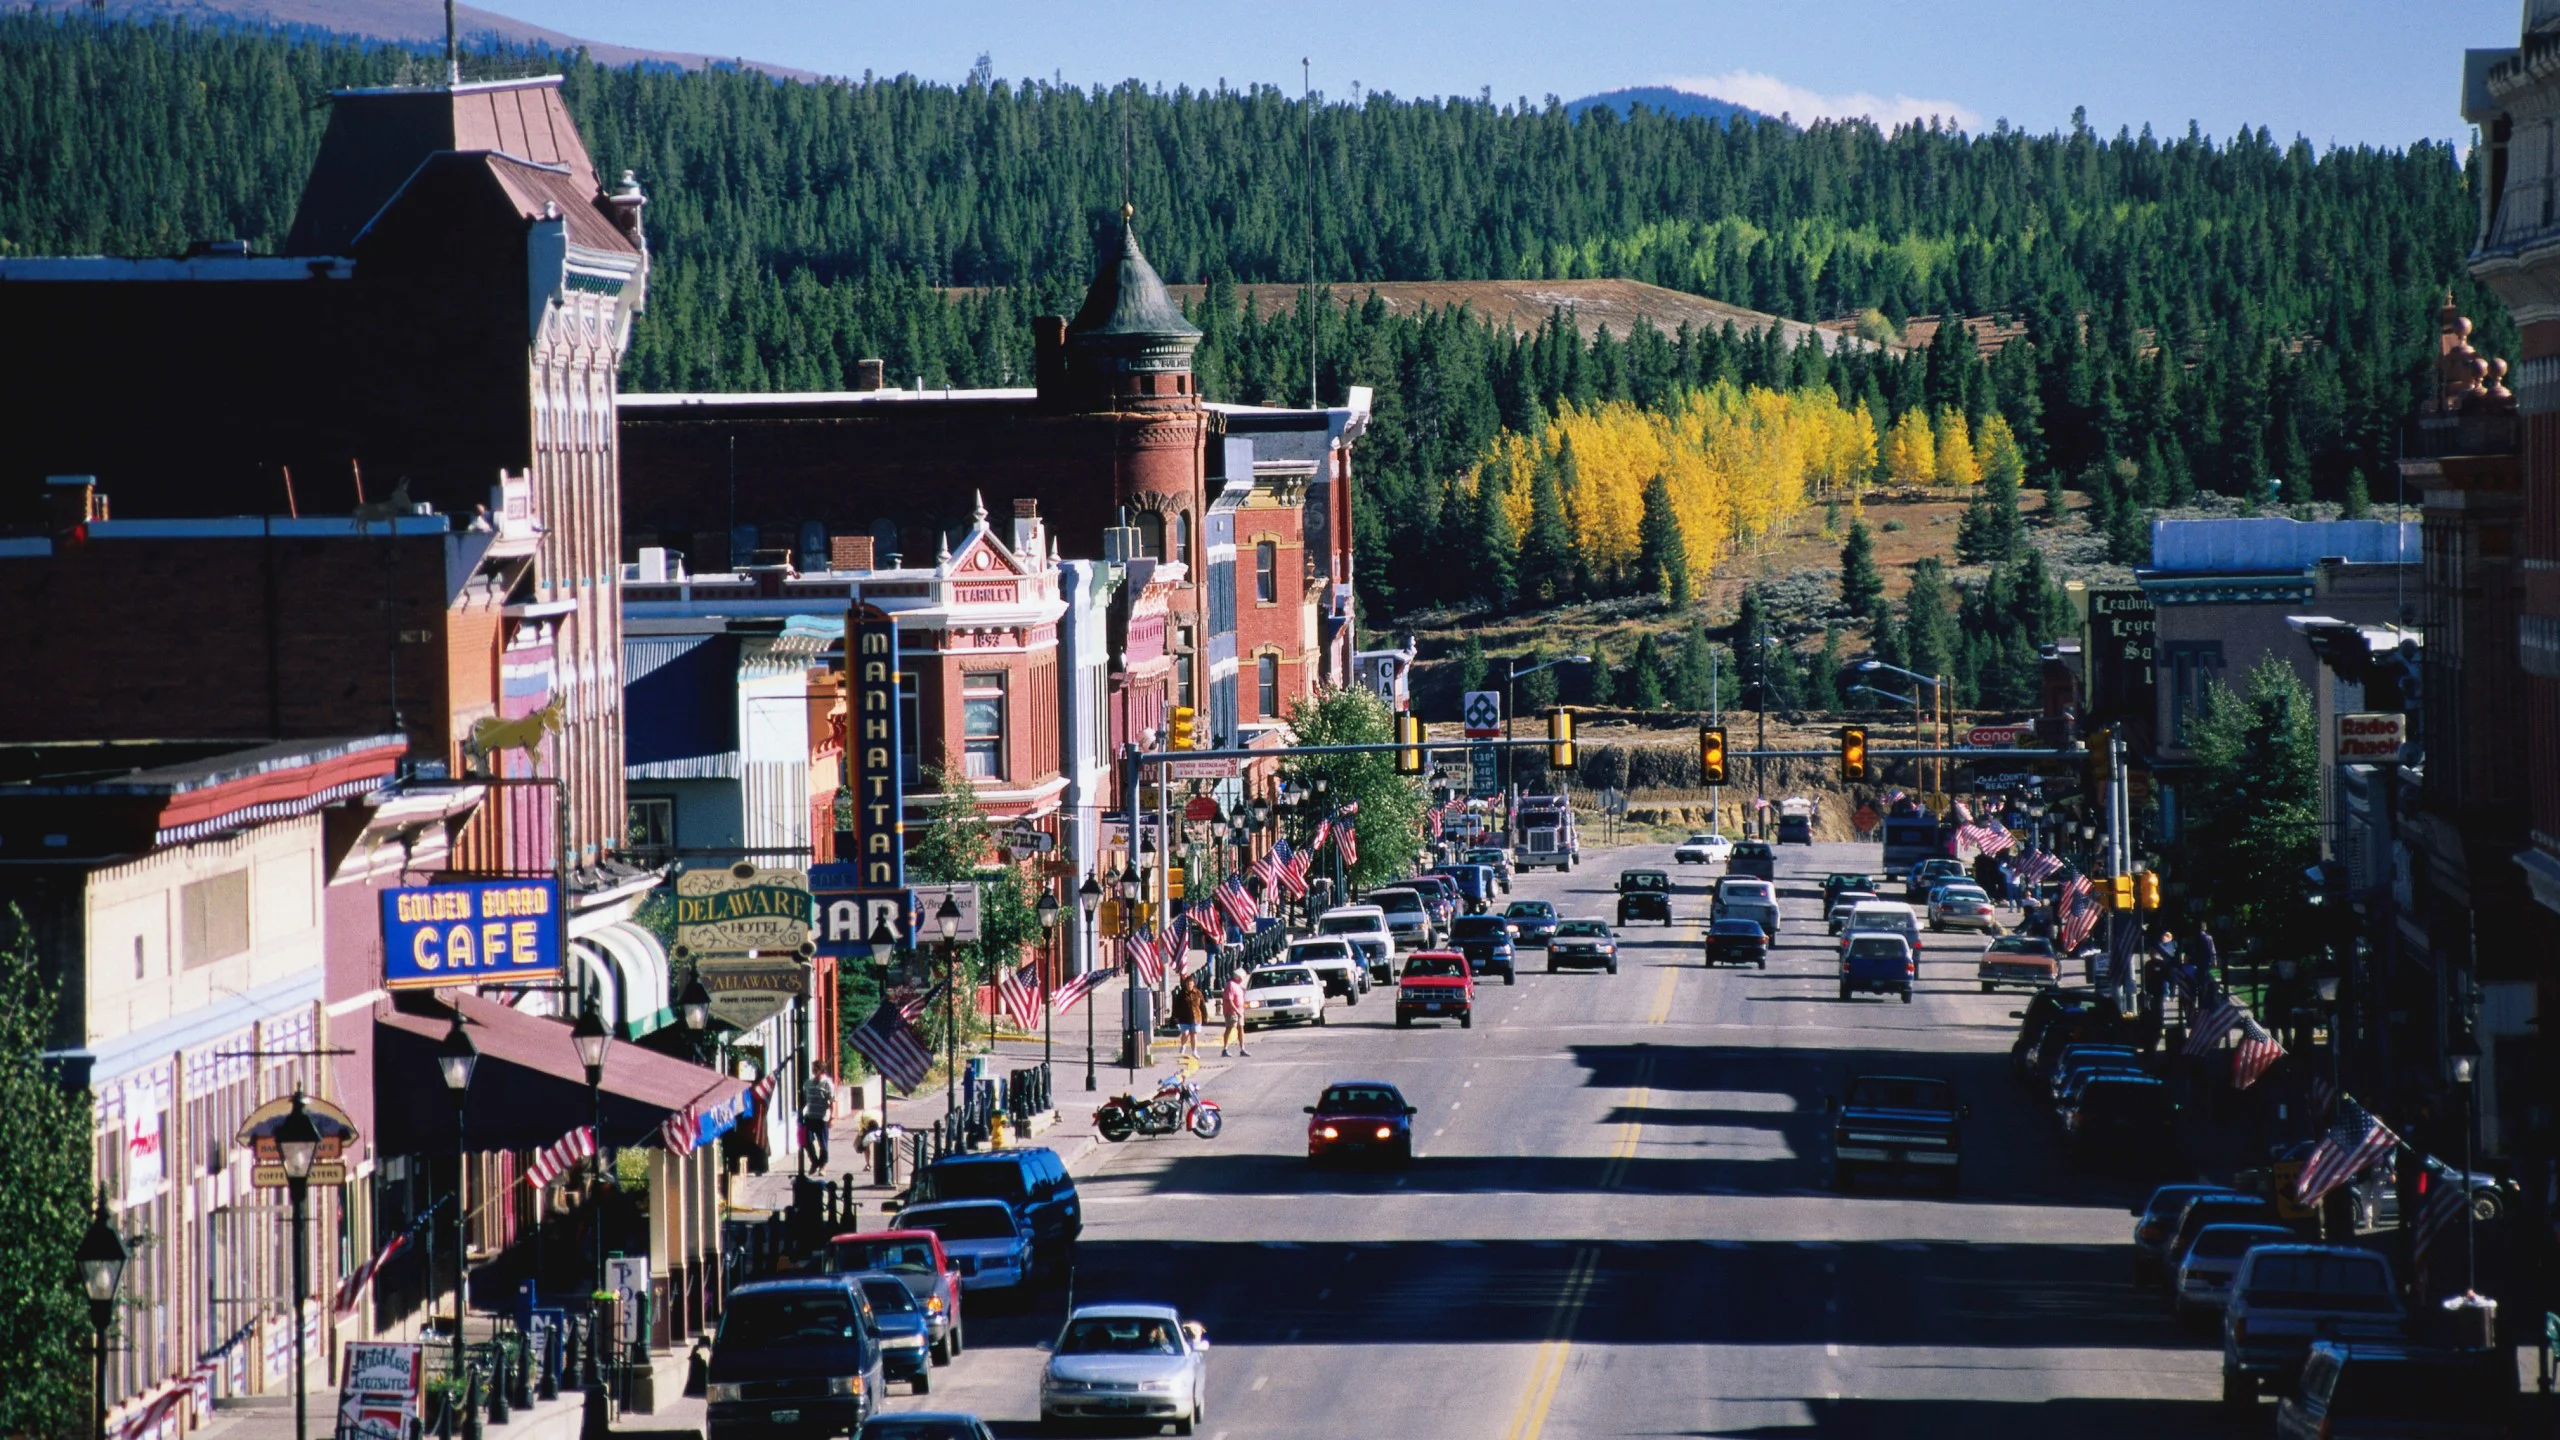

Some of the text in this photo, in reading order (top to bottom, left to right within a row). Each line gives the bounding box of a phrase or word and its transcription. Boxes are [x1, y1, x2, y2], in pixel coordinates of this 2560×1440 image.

[2341, 719, 2399, 735] Radio
[862, 632, 891, 883] MANHATTAN
[398, 887, 549, 923] GOLDEN BURRO
[678, 890, 805, 922] DELAWARE
[413, 921, 538, 970] CAFE
[731, 922, 782, 936] HOTEL
